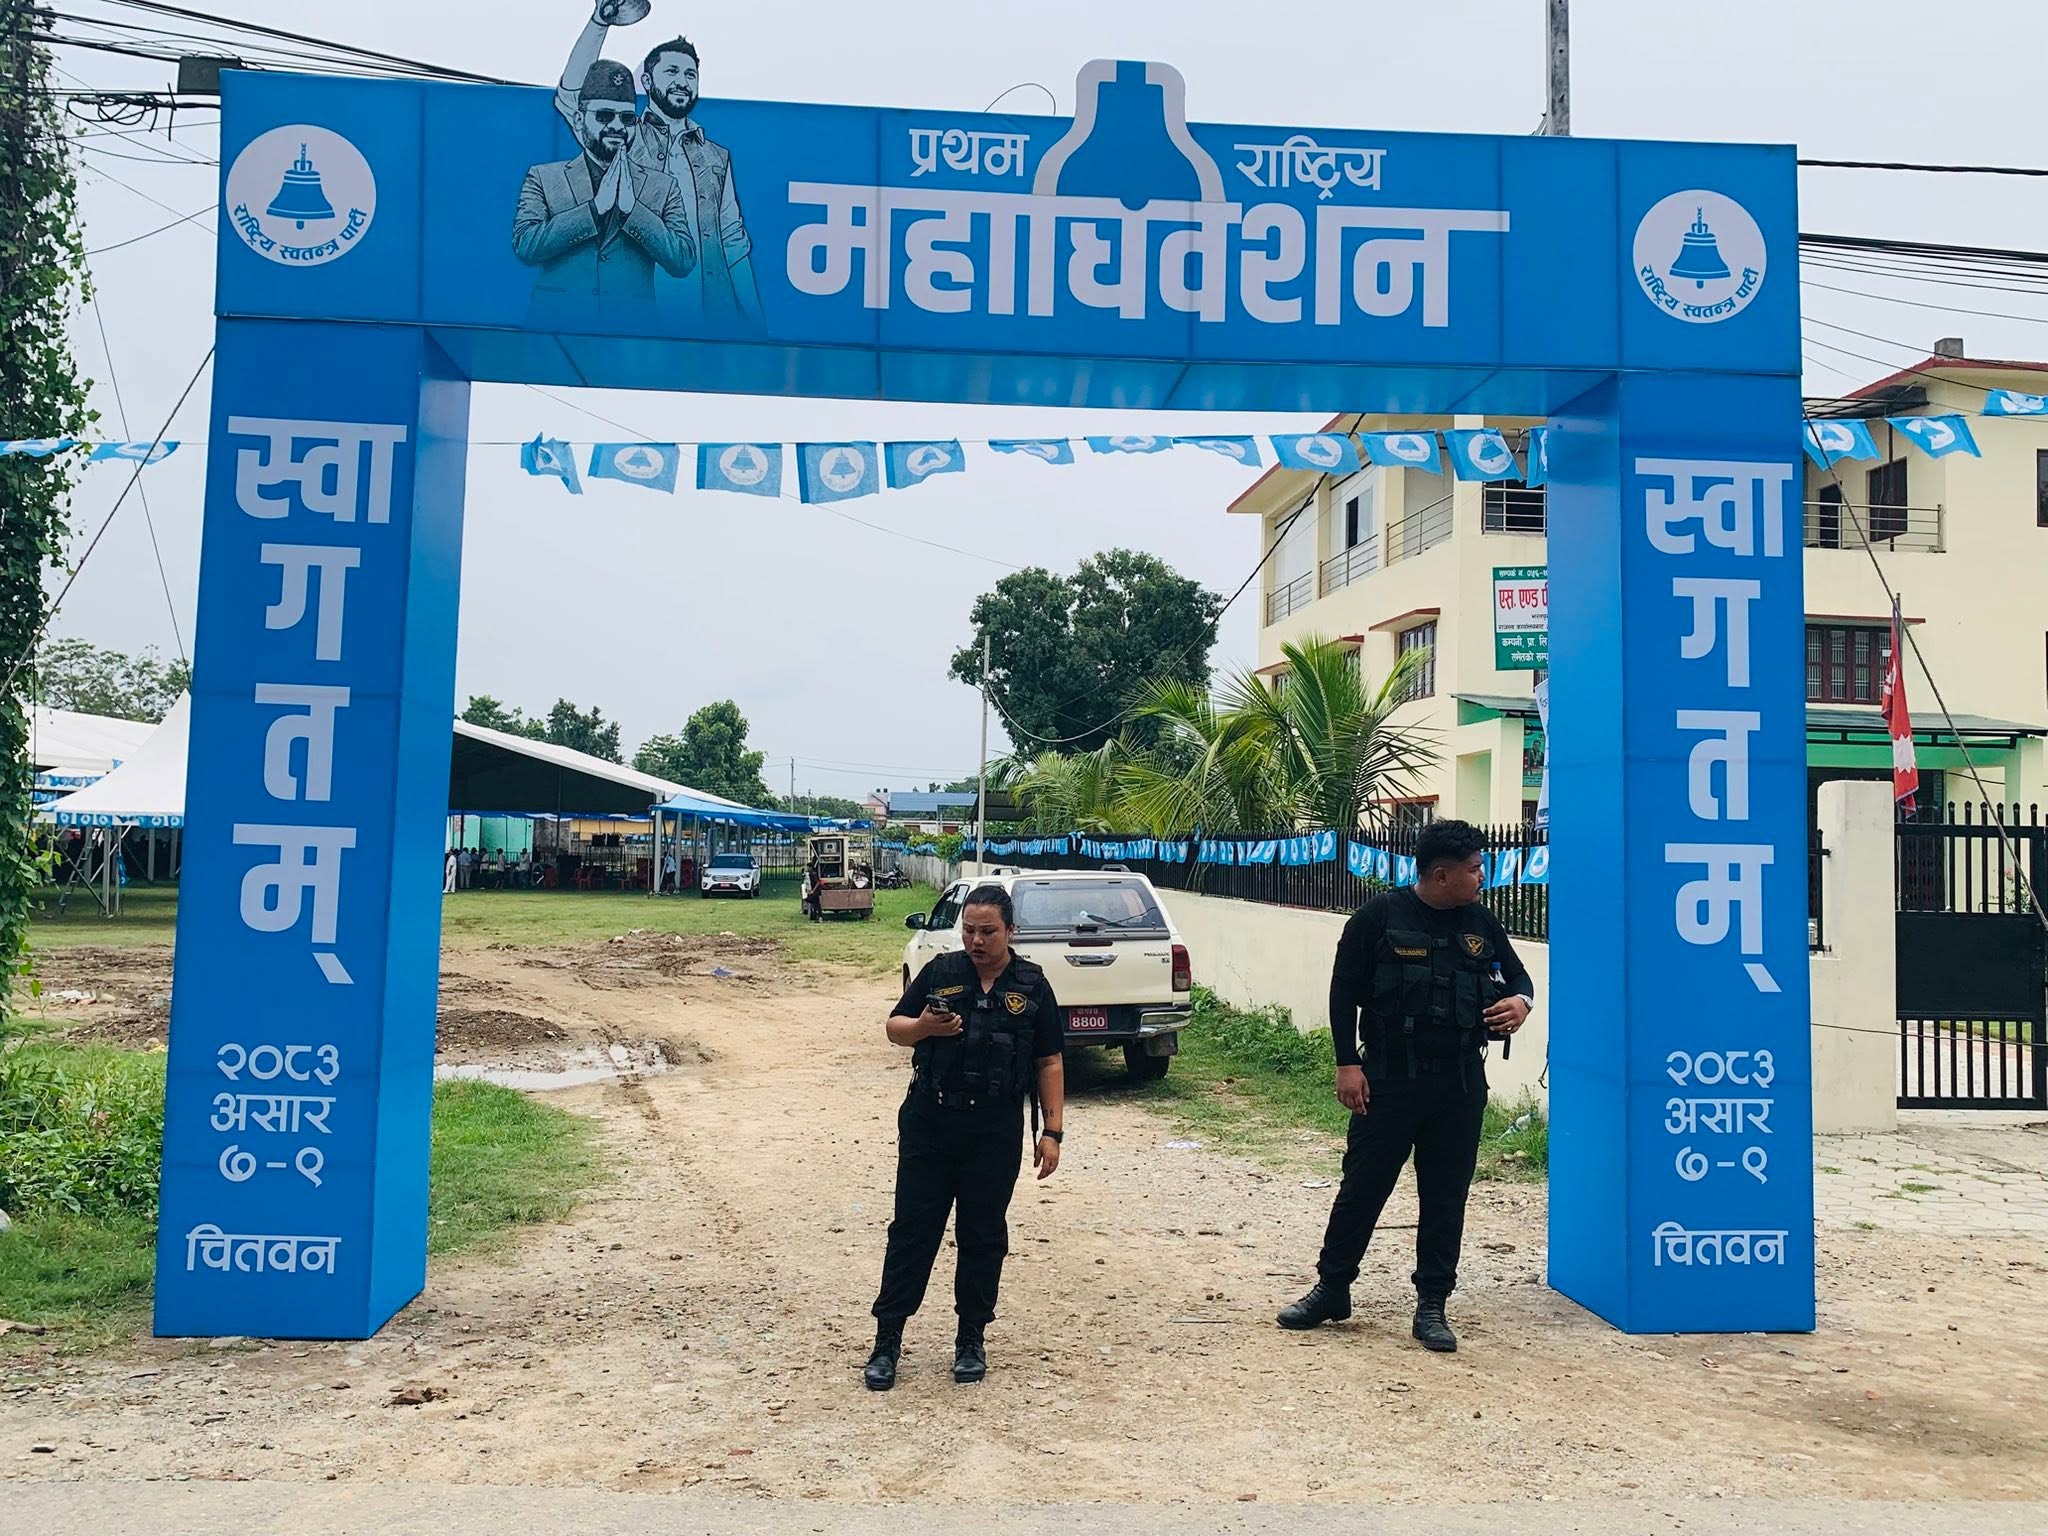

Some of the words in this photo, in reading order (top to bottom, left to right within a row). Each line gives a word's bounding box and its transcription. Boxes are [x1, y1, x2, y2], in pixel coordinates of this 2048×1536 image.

[908, 129, 1031, 176] प्रथम
[1234, 134, 1387, 201] राष्ट्रिय
[1518, 588, 1539, 609] एण्ड
[1072, 1016, 1105, 1028] 8800
[217, 1043, 340, 1086] २०८३
[1666, 1049, 1775, 1089] २०८३
[210, 1092, 337, 1134] असार
[1664, 1097, 1775, 1135] असार
[185, 1223, 342, 1274] चितवन
[1651, 1221, 1789, 1266] चितवन
